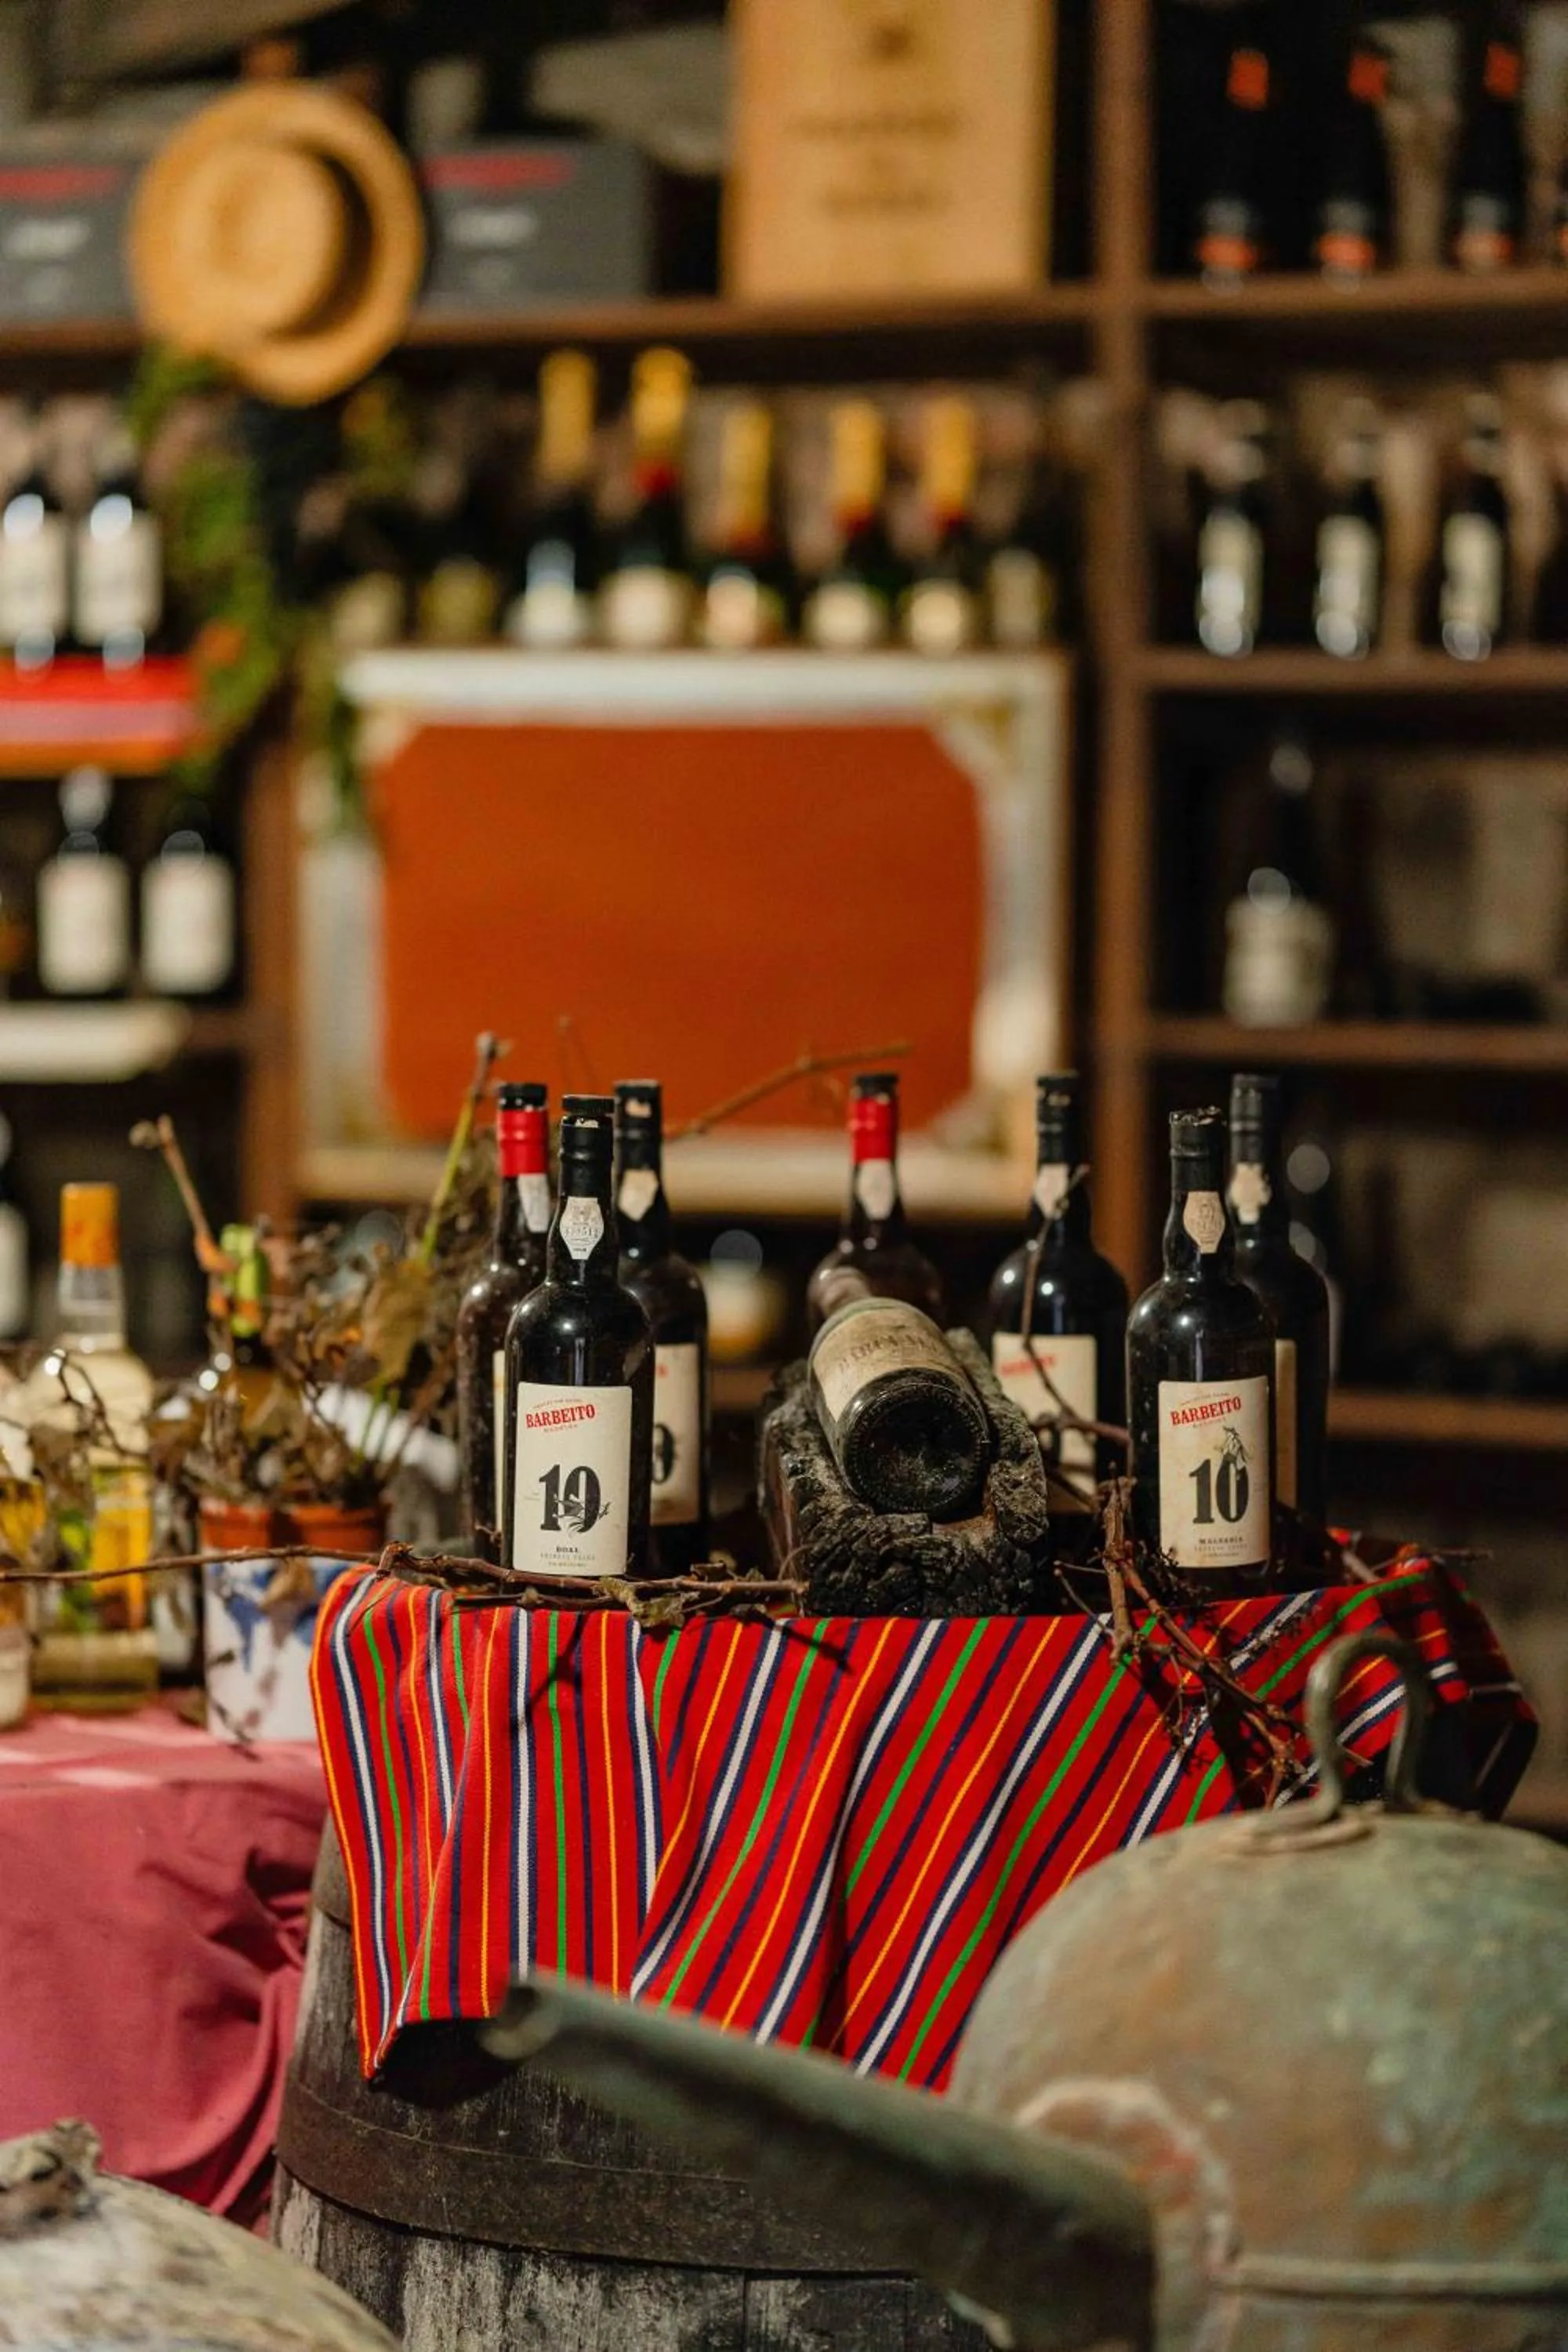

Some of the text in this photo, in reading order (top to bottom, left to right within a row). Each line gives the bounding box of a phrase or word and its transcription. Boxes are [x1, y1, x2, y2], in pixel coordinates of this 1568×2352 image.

[526, 1404, 595, 1428] BARBEITO
[1171, 1396, 1241, 1425] BARBEITO
[539, 1464, 601, 1533] 10
[1189, 1457, 1249, 1524] 10
